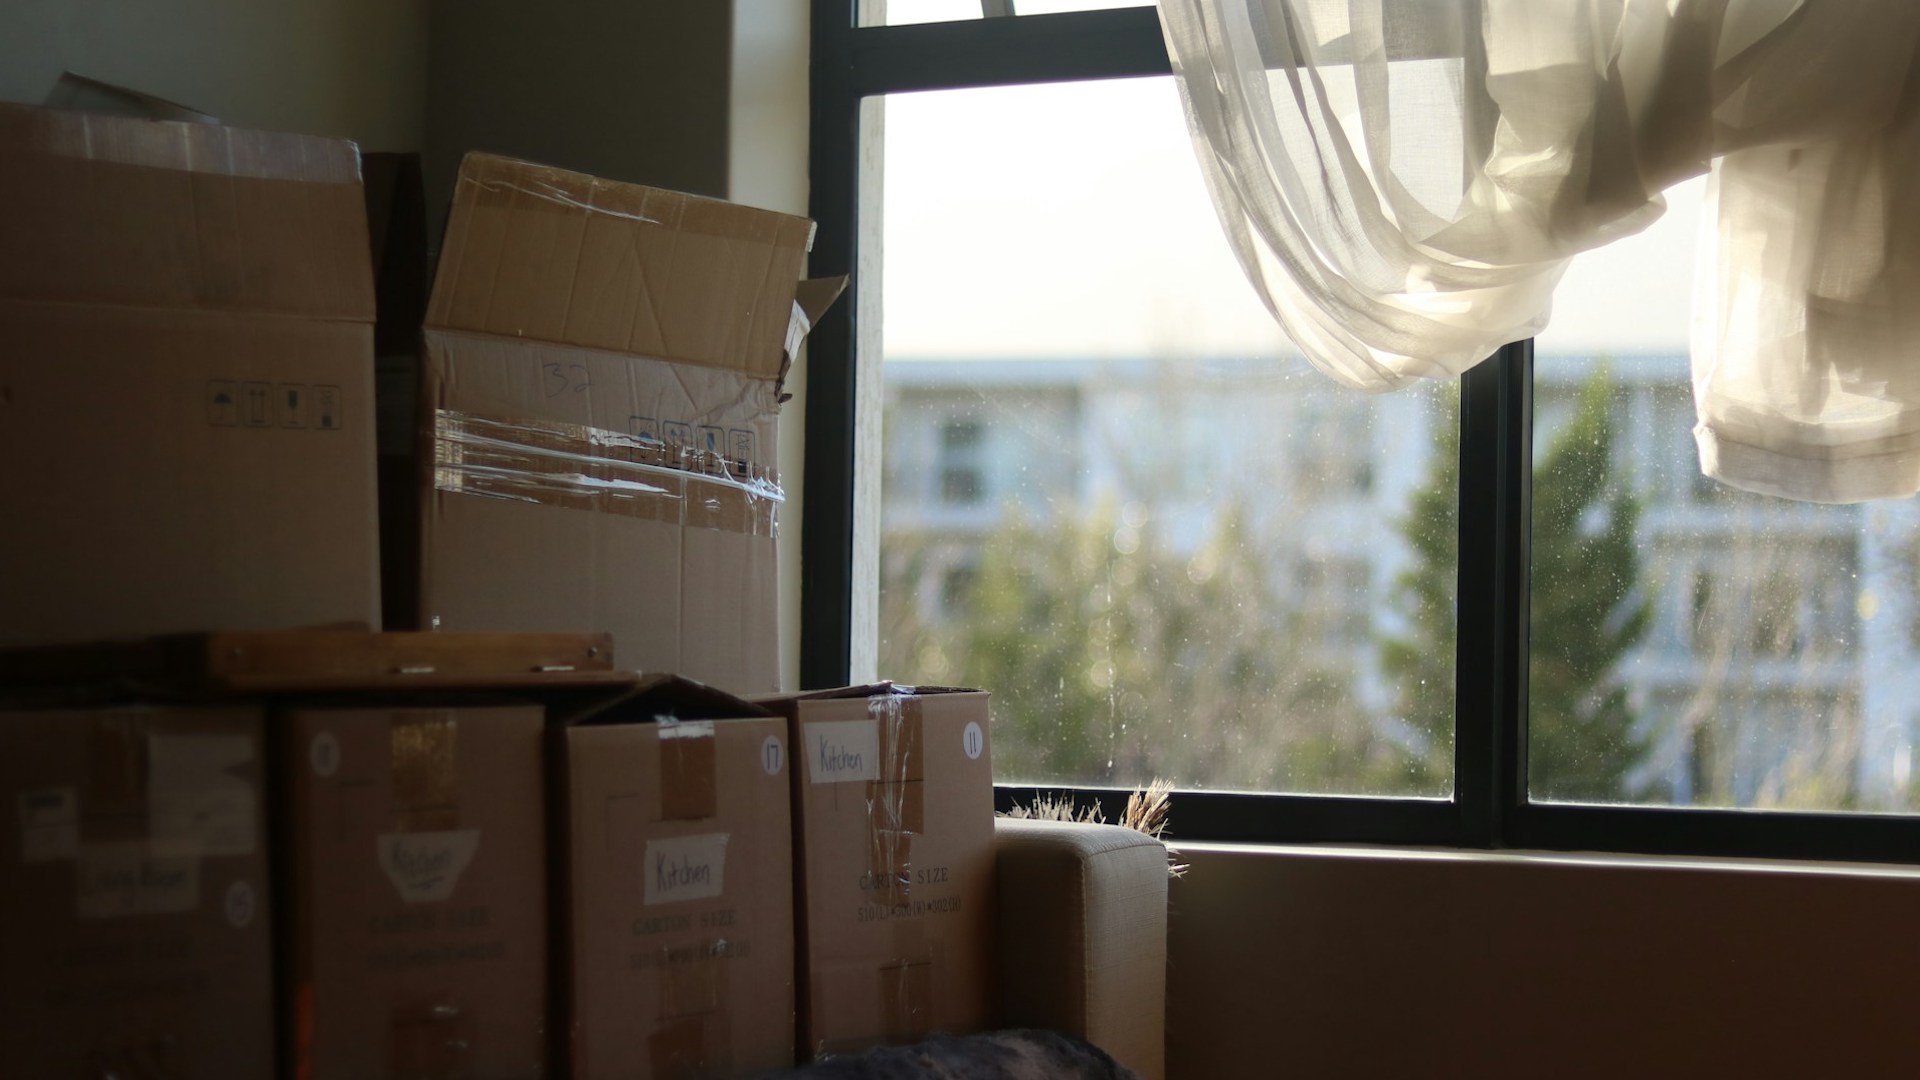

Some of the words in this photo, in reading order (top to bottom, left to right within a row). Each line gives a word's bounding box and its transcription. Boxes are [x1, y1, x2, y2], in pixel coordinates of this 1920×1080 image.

[542, 362, 595, 398] 32
[819, 735, 863, 774] Kitchen
[968, 731, 977, 755] 11
[766, 744, 779, 770] 17
[656, 849, 711, 893] Kitchen
[917, 866, 949, 885] SIZE
[699, 908, 736, 929] SIZE
